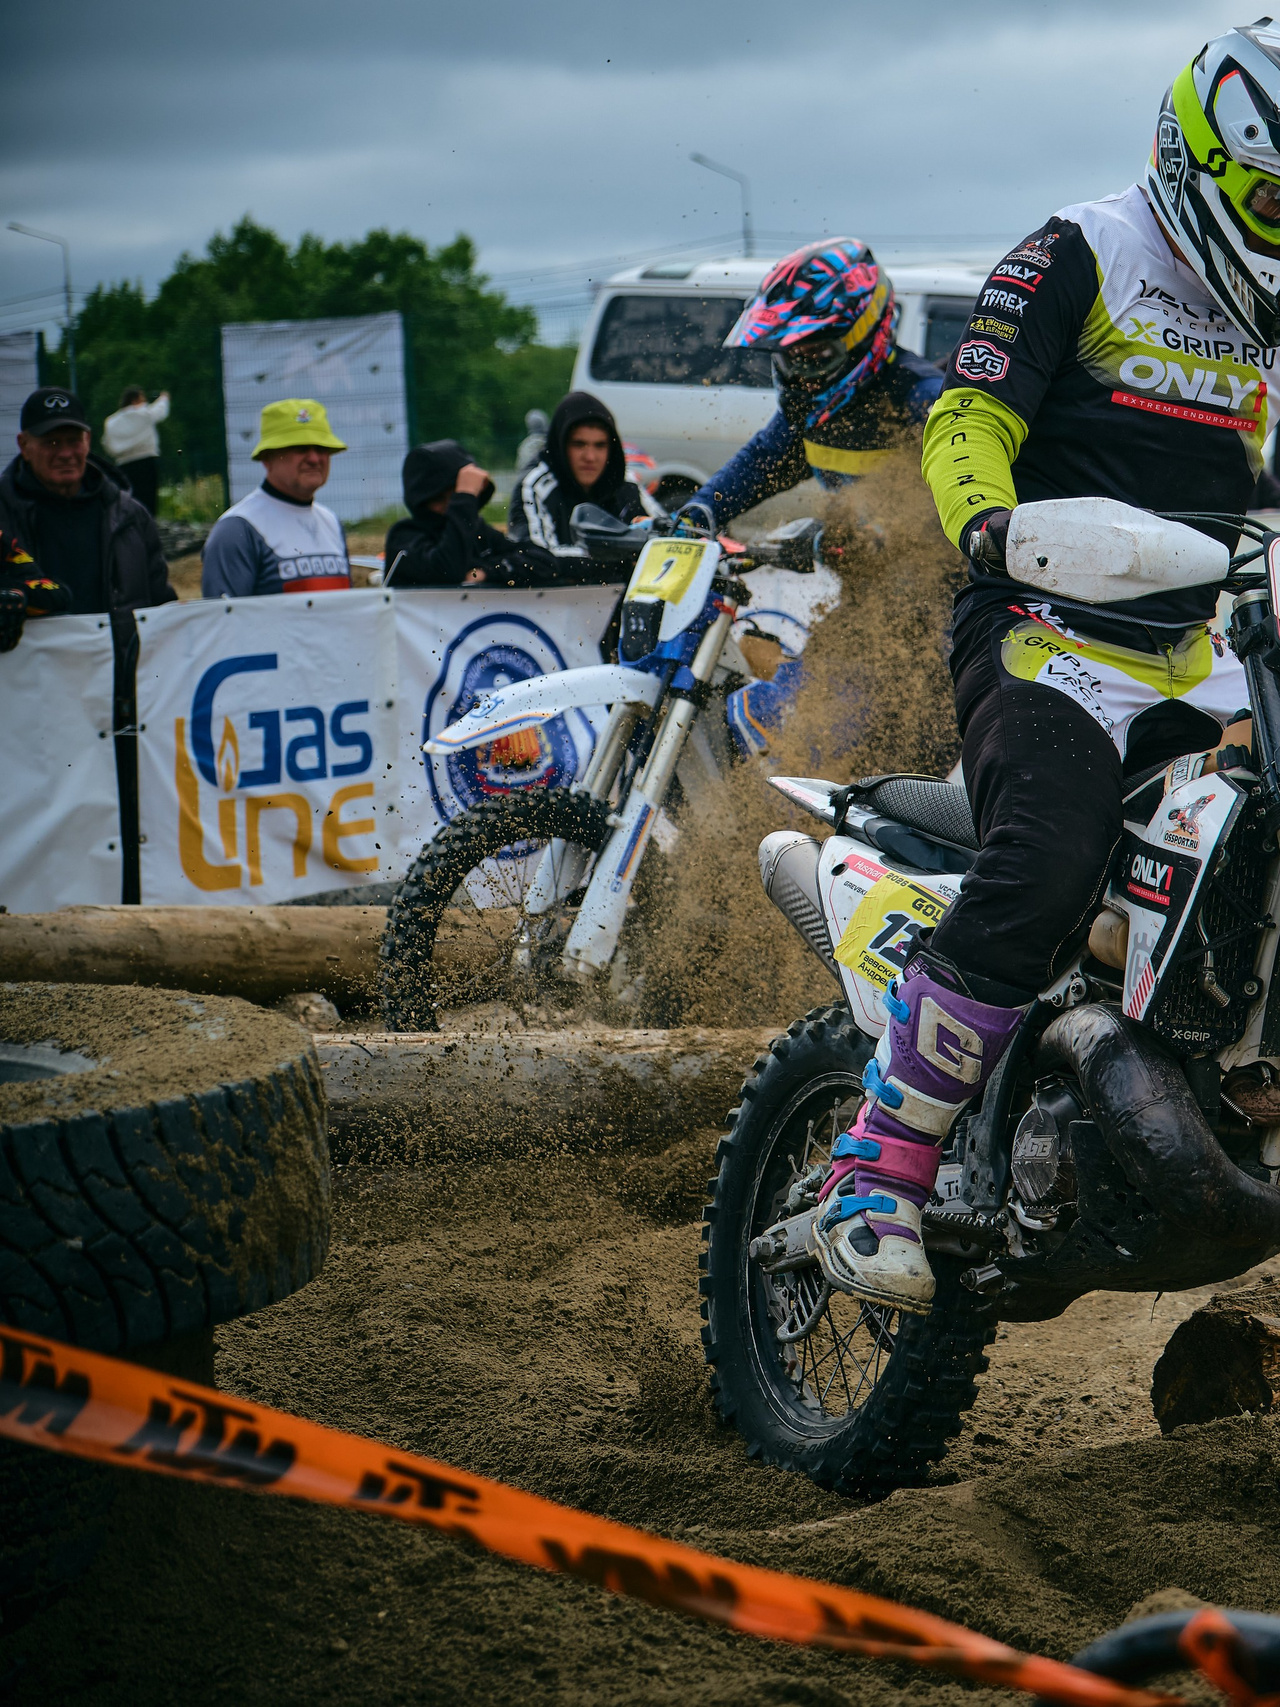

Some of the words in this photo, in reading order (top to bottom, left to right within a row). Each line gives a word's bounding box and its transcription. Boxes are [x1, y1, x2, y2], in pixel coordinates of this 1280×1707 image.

[995, 264, 1043, 286] ONLY1
[985, 318, 1016, 335] ENDURO
[1163, 309, 1240, 333] RACIN
[1126, 317, 1277, 370] X-GRIP.RU
[1119, 355, 1268, 413] ONLY1
[1122, 395, 1179, 415] EXTREME
[1183, 410, 1225, 424] ENDURO
[1227, 419, 1253, 429] PARTS
[950, 398, 987, 506] RACING
[652, 557, 677, 584] 1
[191, 653, 373, 789] Gas
[1165, 833, 1199, 850] OSSPORT.RU
[854, 861, 882, 878] Husqvarn
[885, 872, 908, 887] 2026
[1131, 854, 1174, 891] ONLY1
[911, 898, 943, 923] GOL
[857, 962, 888, 987] Андре
[858, 950, 896, 979] Гаевски
[1171, 1029, 1211, 1042] X-GRIP
